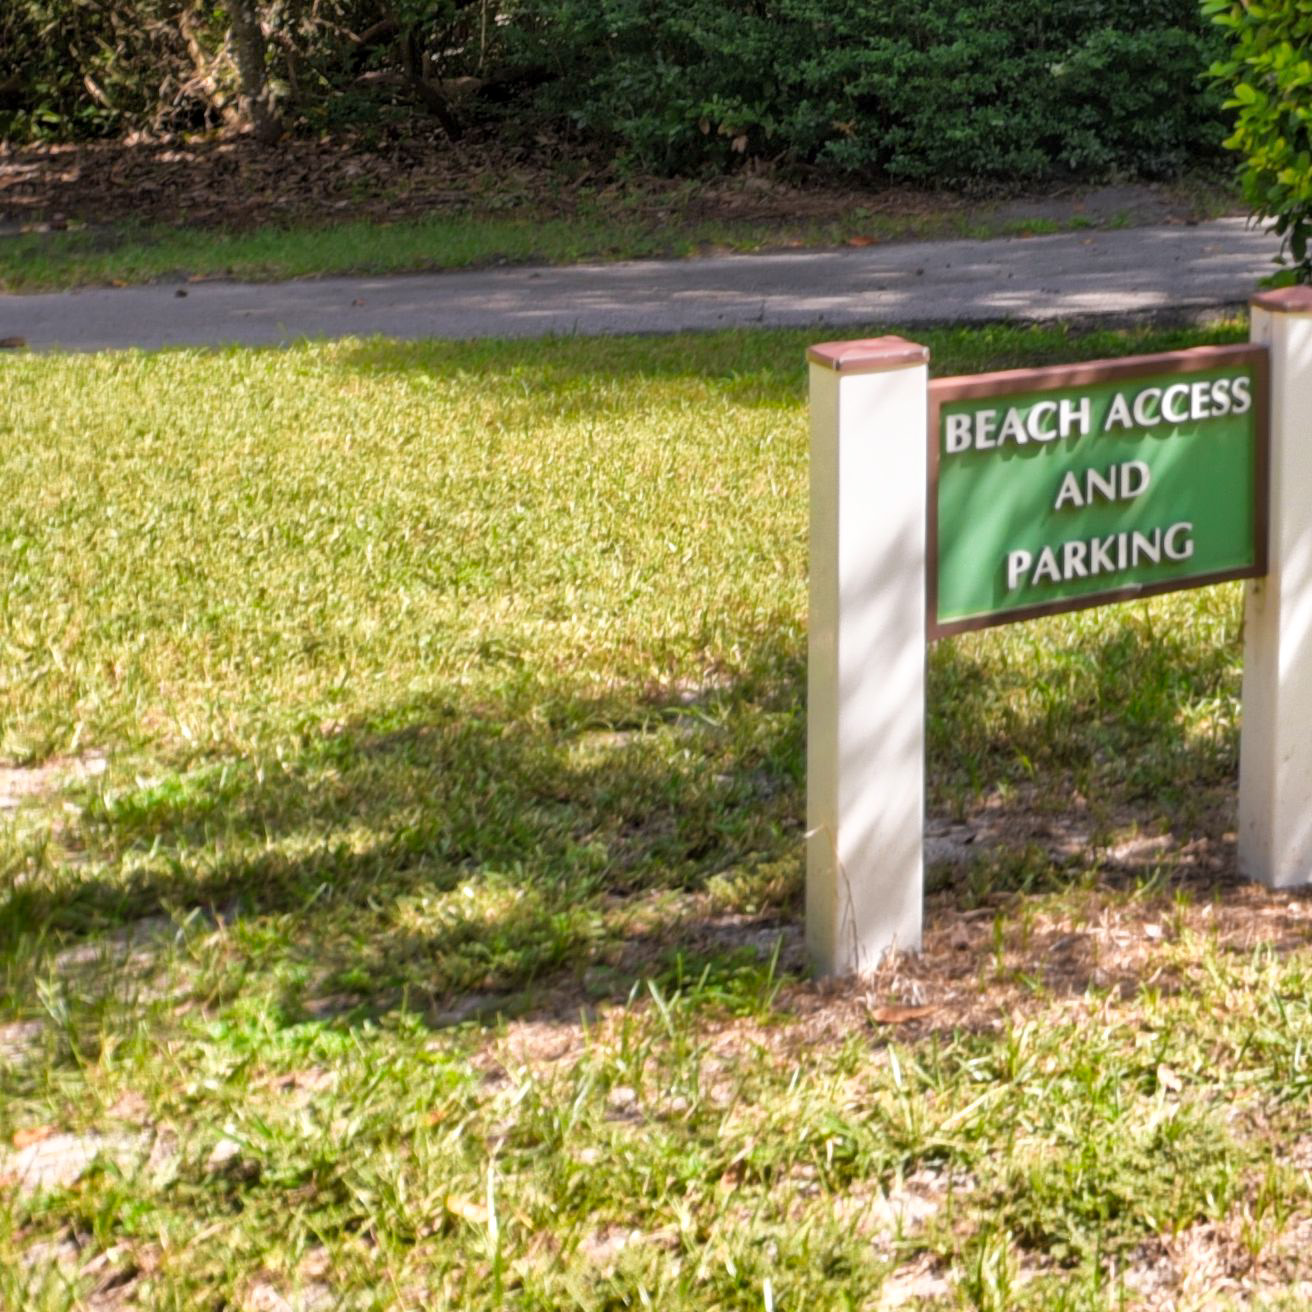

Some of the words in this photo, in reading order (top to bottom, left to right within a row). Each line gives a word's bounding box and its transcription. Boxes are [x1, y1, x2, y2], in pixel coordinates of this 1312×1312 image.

[945, 396, 1090, 453] BEACH
[1104, 376, 1252, 431] ACCESS
[1054, 460, 1150, 510] AND
[1007, 521, 1194, 589] PARKING
